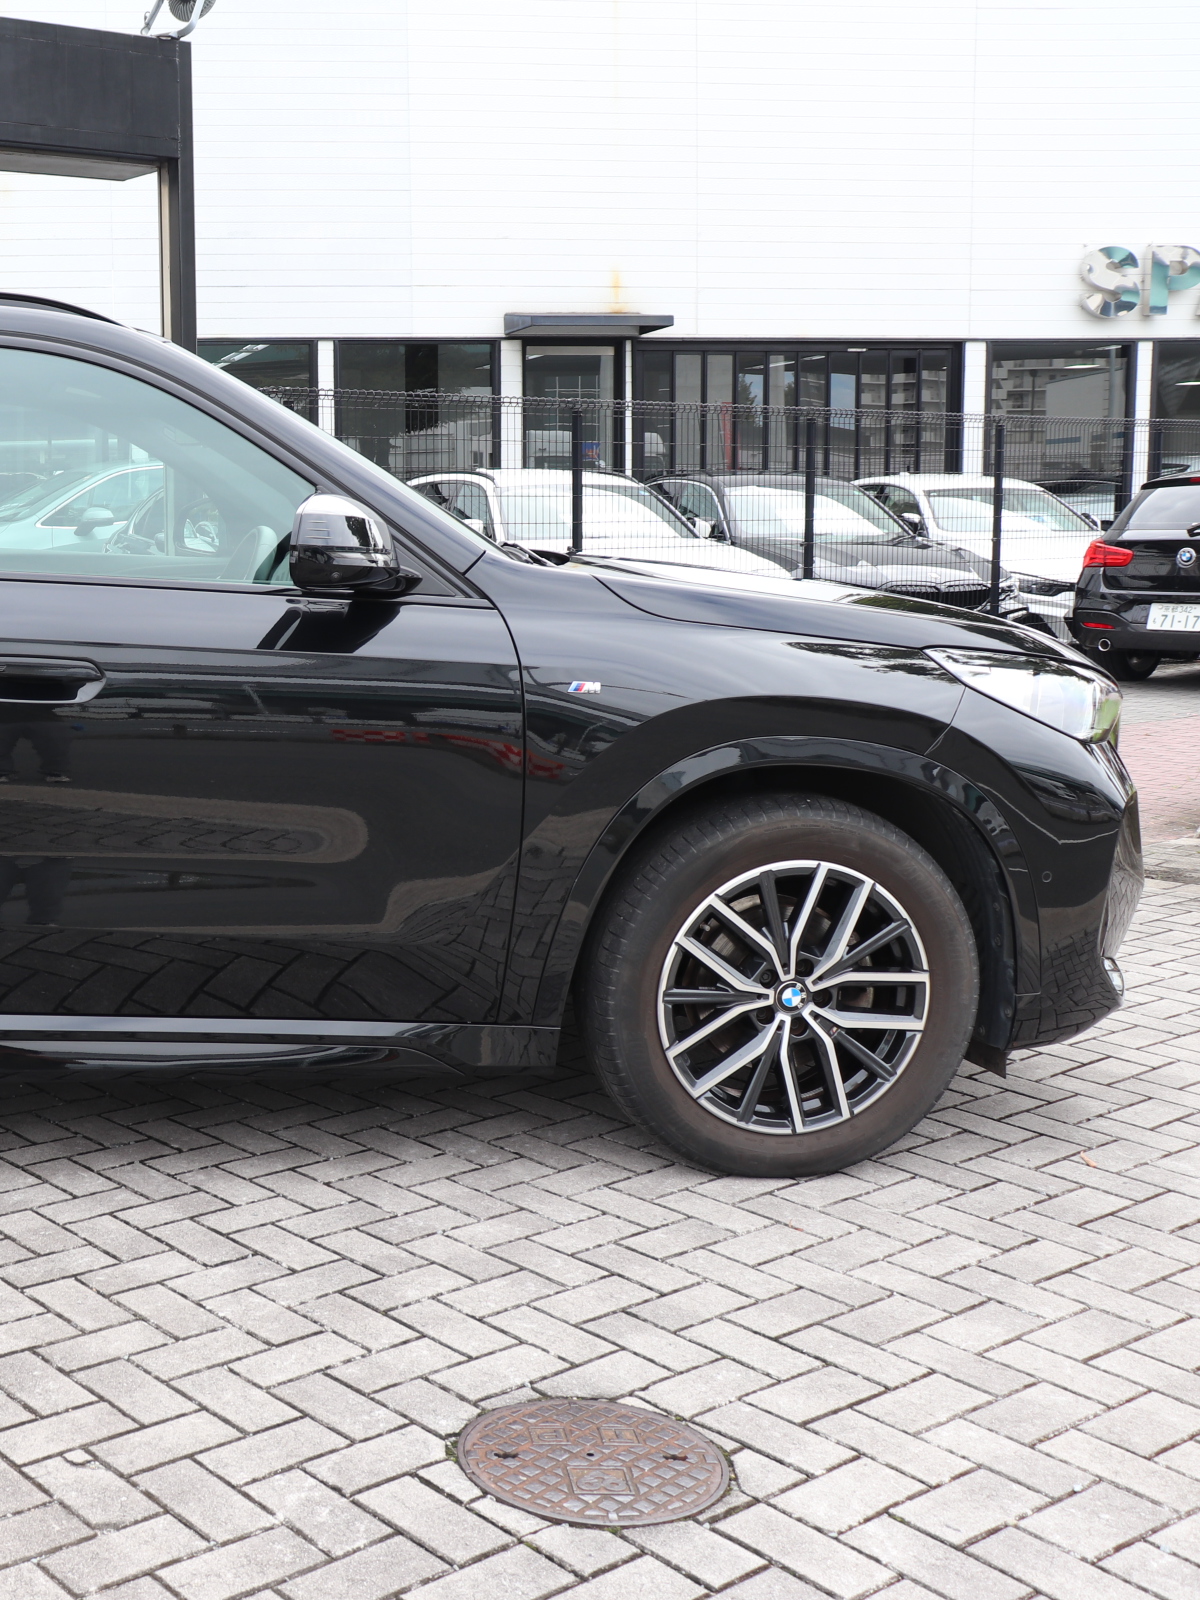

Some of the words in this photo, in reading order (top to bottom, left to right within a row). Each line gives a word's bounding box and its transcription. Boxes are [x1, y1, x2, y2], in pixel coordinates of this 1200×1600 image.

[1079, 245, 1200, 318] SP
[1179, 605, 1192, 613] 342
[1160, 614, 1200, 629] 71-17
